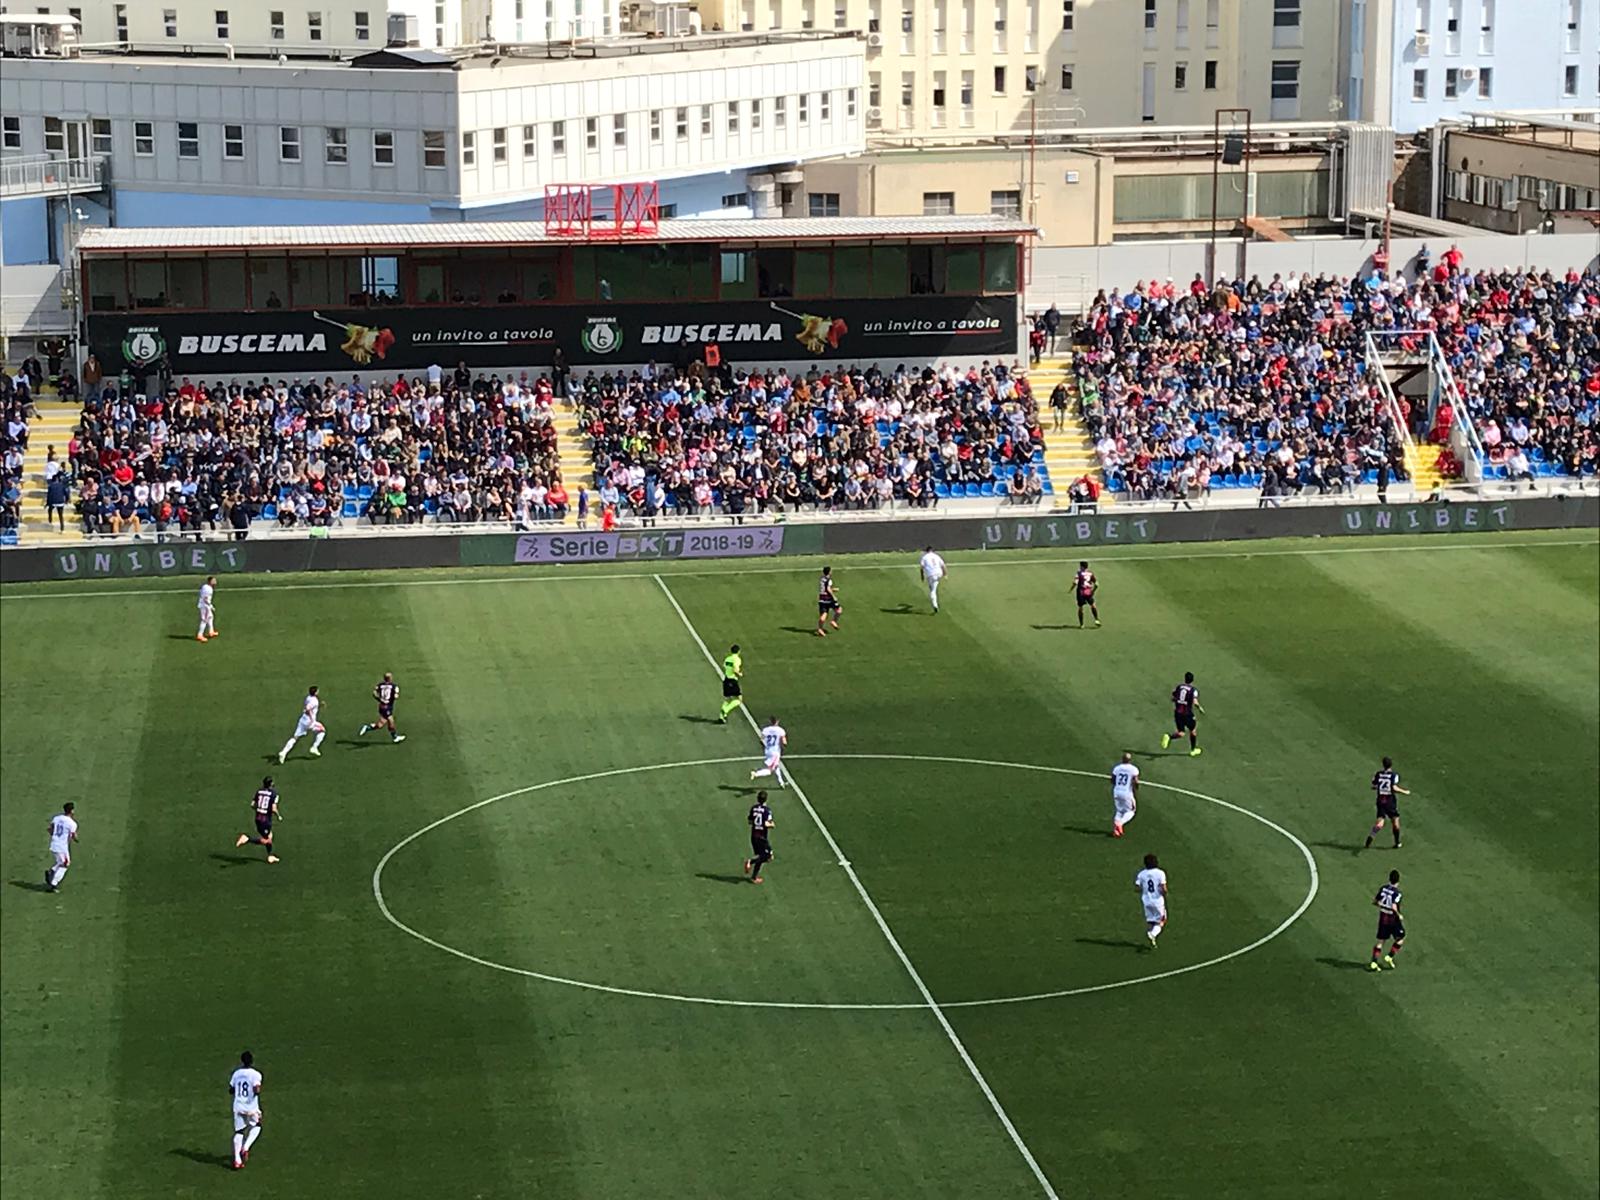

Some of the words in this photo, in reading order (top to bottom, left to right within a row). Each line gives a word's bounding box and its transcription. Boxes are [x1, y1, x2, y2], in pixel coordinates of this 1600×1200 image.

[642, 324, 782, 344] BUSCEMA
[864, 321, 883, 331] un
[888, 319, 932, 330] invito
[937, 321, 946, 329] a
[952, 317, 1000, 329] tavola
[178, 333, 327, 354] BUSCEMA
[412, 332, 431, 341] un
[437, 329, 484, 340] invito
[488, 331, 497, 340] a
[504, 328, 553, 339] tavola
[1346, 507, 1507, 529] UNIBET
[986, 519, 1148, 542] UNIBET
[550, 537, 609, 557] Serie
[618, 537, 682, 553] BKT
[690, 534, 753, 550] 2018-19
[60, 548, 237, 573] UNIBET
[767, 734, 777, 747] 27
[1148, 879, 1155, 893] 8
[238, 1081, 249, 1097] 18
